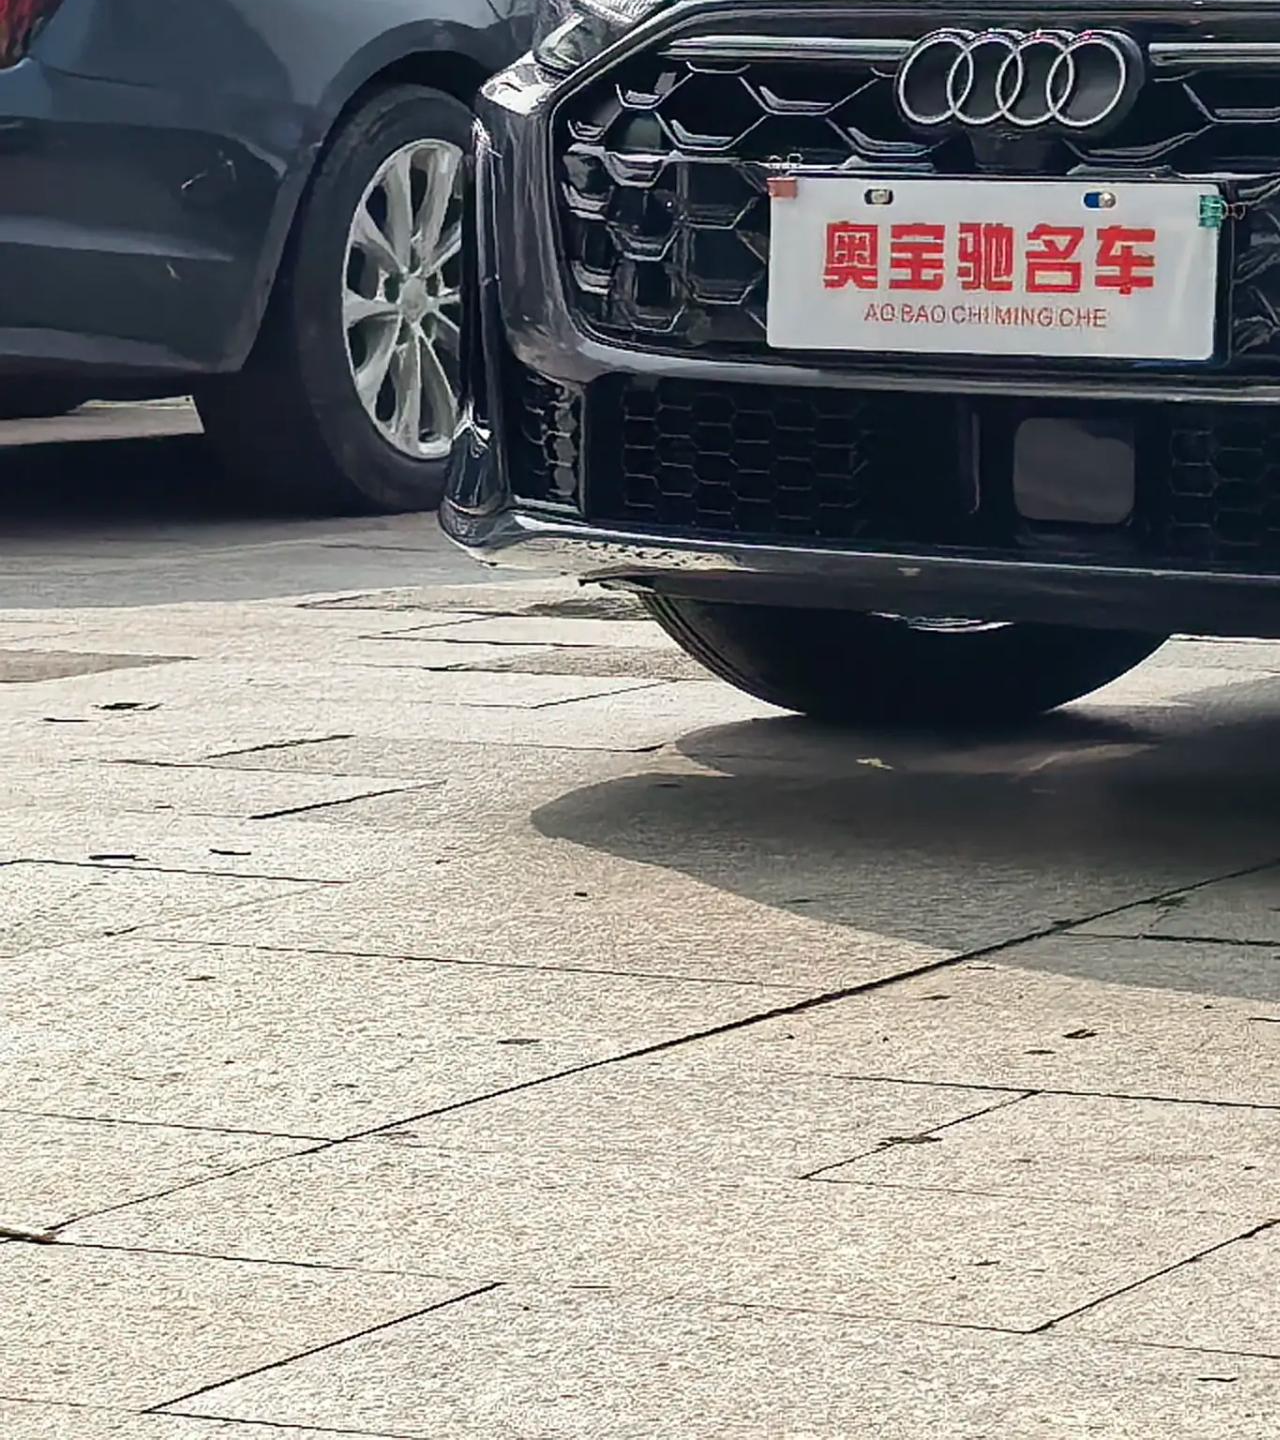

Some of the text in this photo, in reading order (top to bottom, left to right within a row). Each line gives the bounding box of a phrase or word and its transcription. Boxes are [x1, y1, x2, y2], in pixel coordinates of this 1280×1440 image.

[823, 221, 1156, 295] 奥宝驰名车
[901, 303, 946, 324] BAO
[951, 304, 989, 325] CHI
[995, 305, 1054, 327] MING
[1058, 307, 1107, 328] CHE
